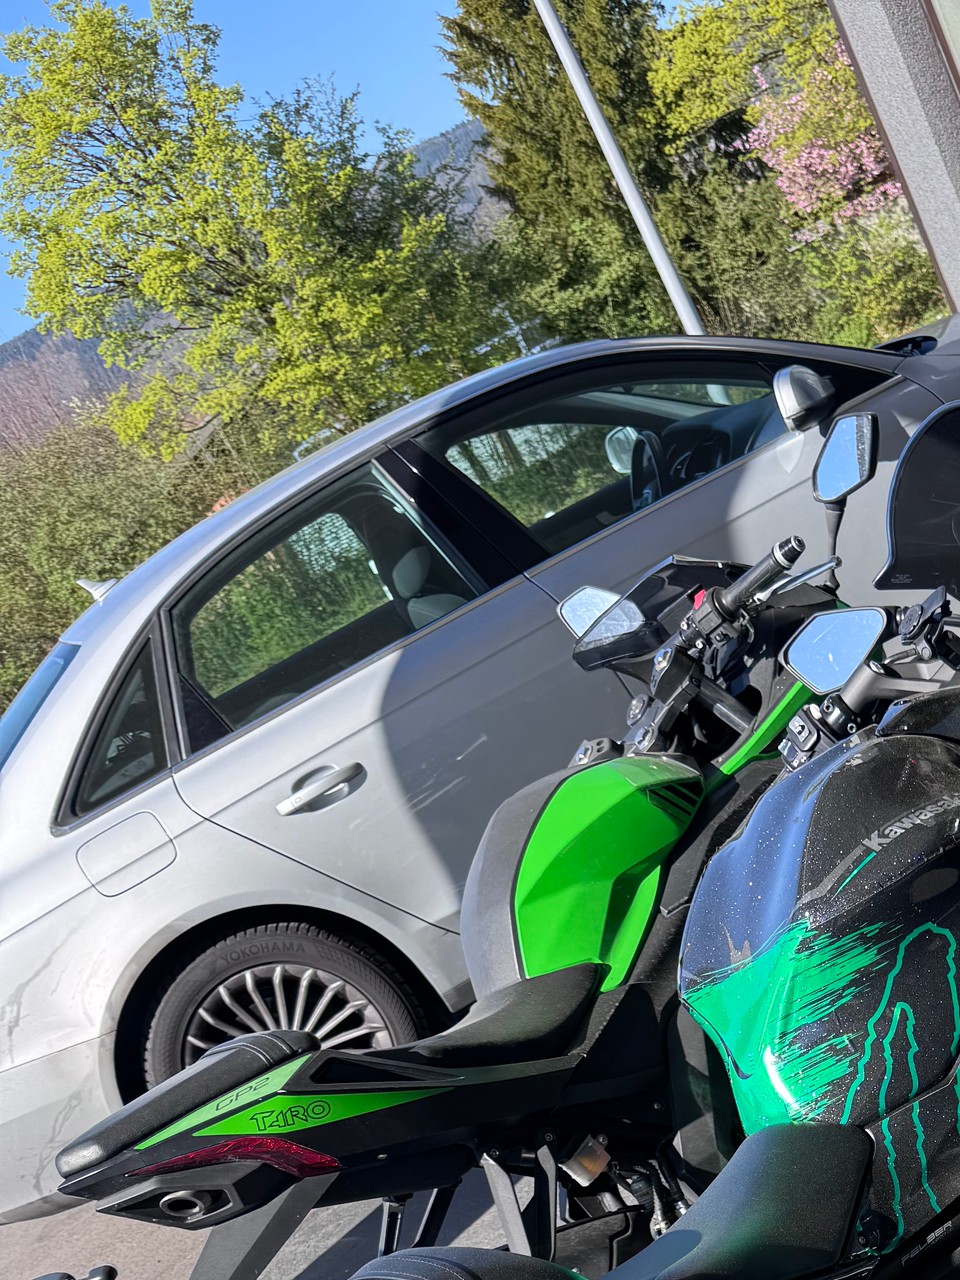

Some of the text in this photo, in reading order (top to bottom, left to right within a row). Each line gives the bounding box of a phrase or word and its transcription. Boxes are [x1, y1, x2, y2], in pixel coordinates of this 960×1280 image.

[220, 942, 306, 965] YOKOHAMA
[215, 1077, 270, 1111] GP2
[249, 1099, 332, 1132] TARO
